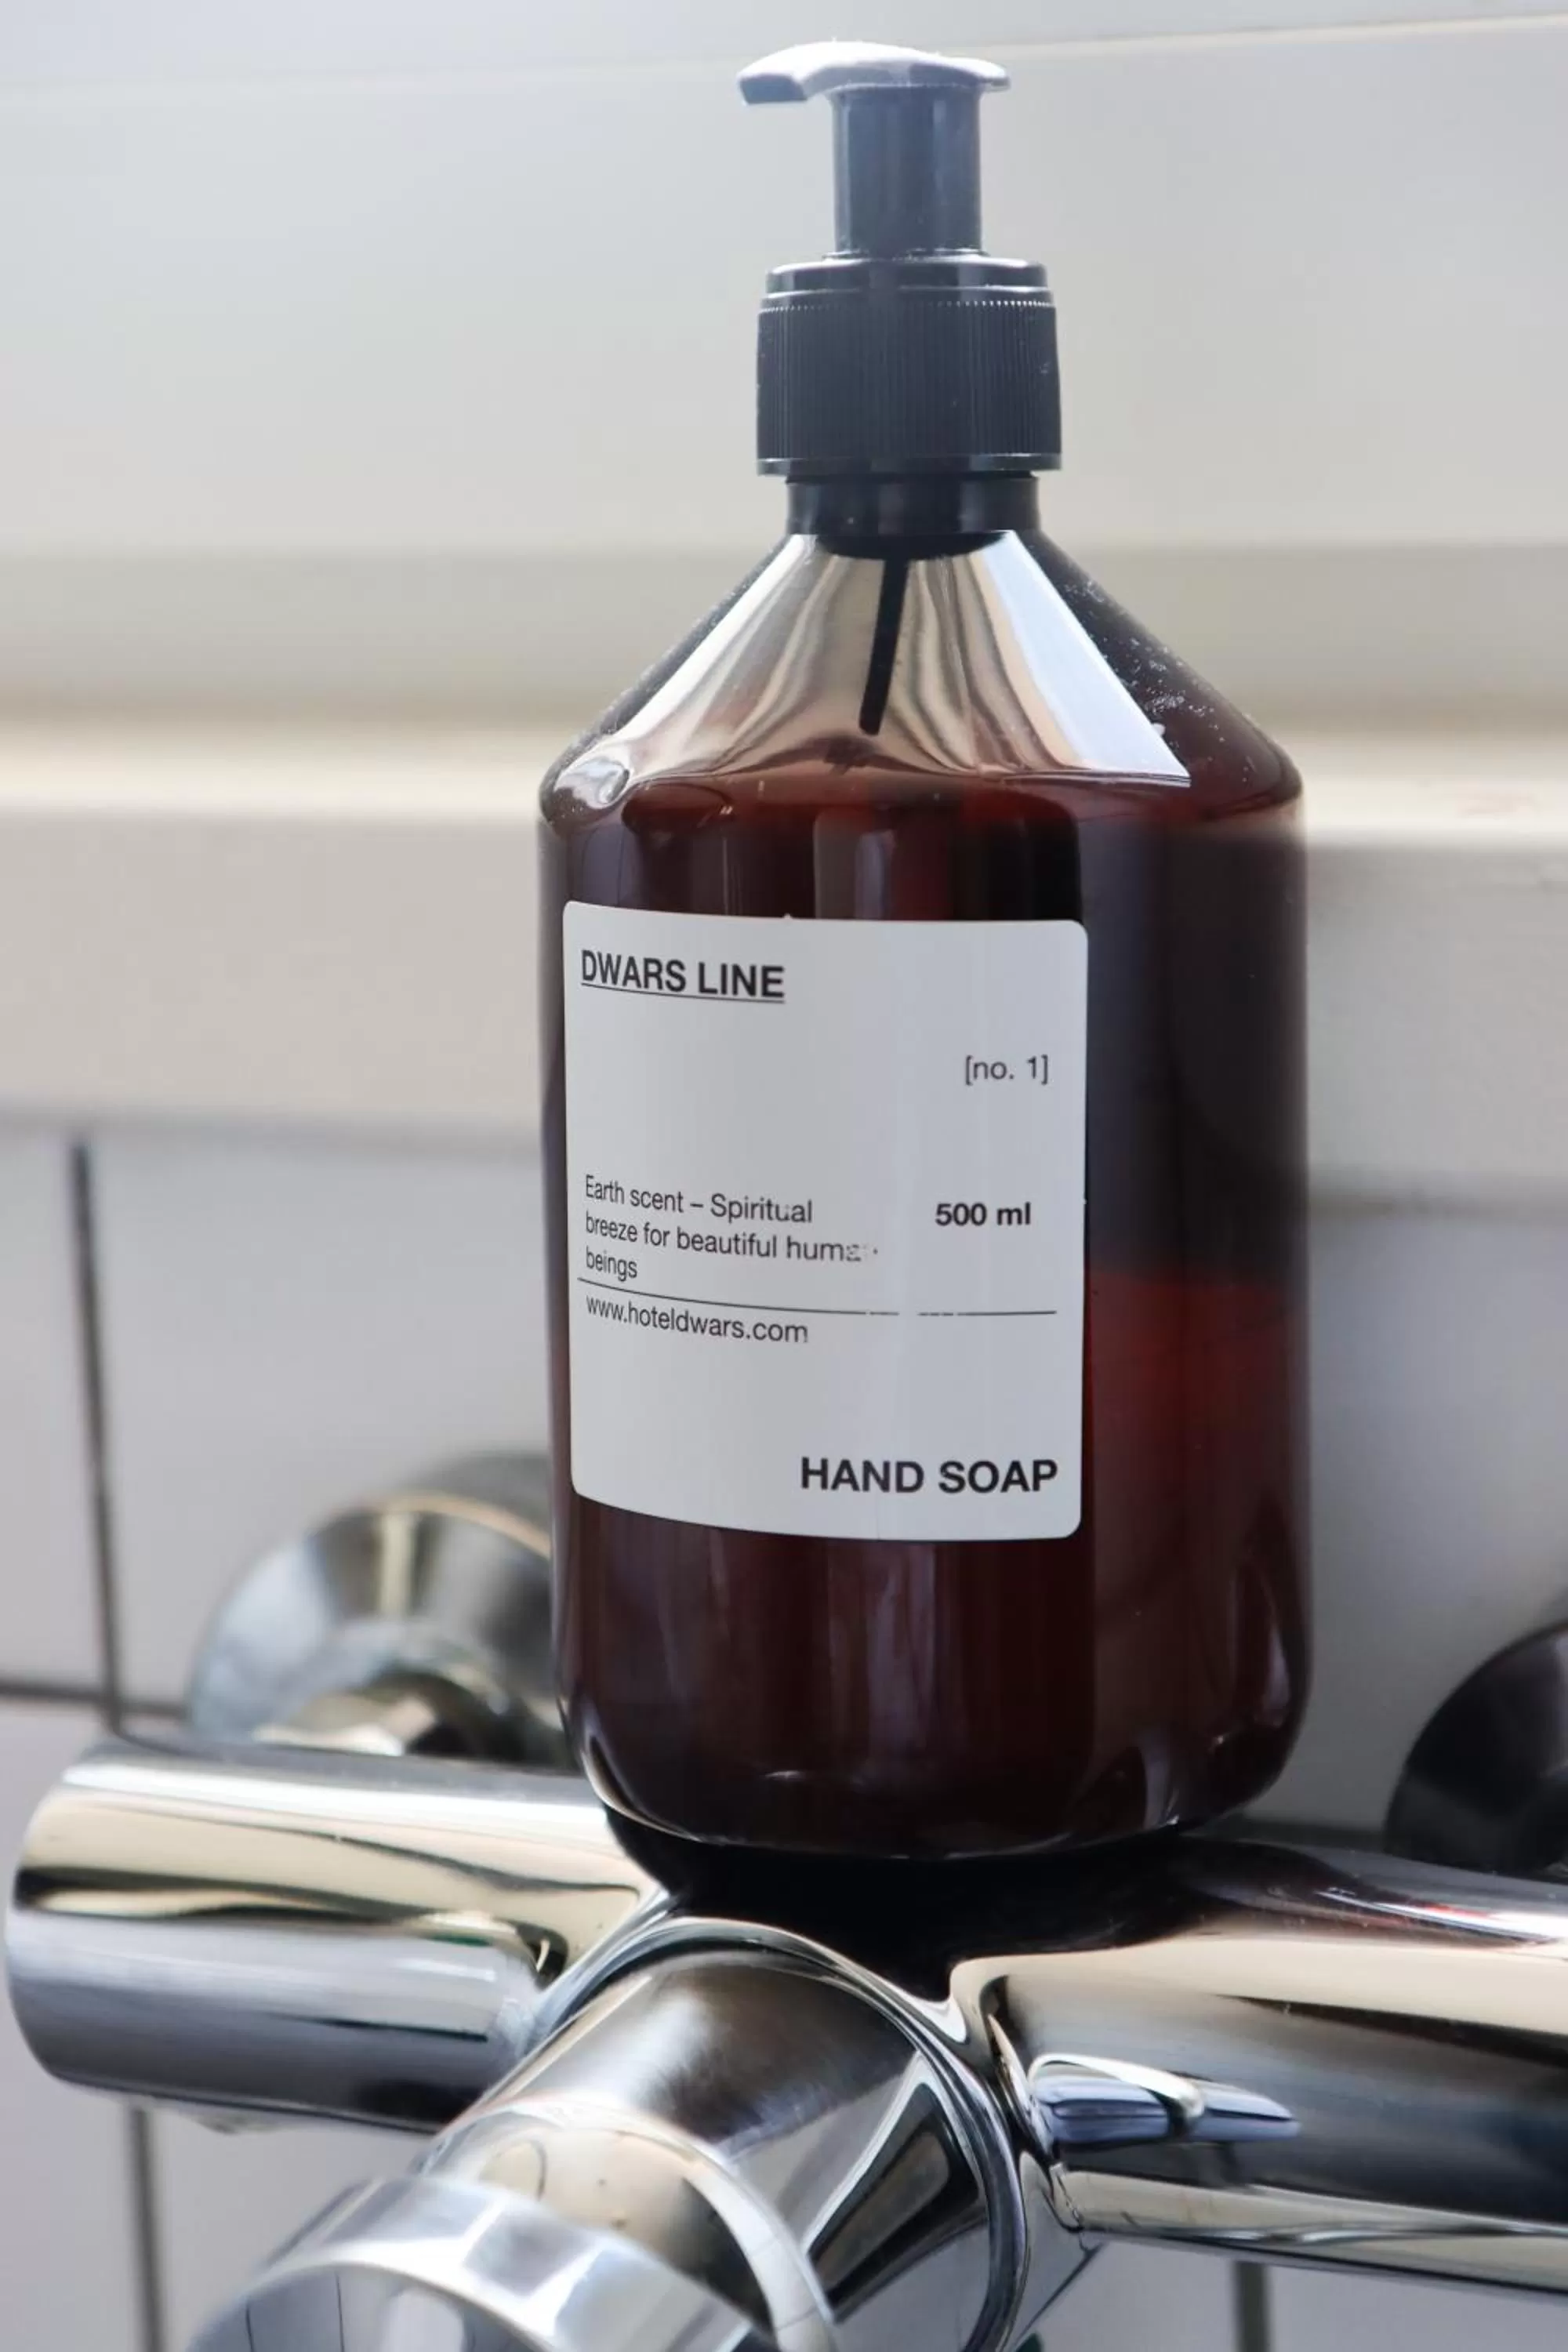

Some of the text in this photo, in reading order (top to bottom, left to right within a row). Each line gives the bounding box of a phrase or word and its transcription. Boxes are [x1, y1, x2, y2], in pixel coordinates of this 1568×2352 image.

[580, 949, 786, 998] DWARS LINE
[964, 1054, 1049, 1087] [no. 1]
[585, 1174, 626, 1205] Earth
[629, 1189, 684, 1214] scent
[710, 1192, 813, 1225] Spiritual
[934, 1200, 1033, 1228] 500 ml
[585, 1210, 879, 1263] breeze for beautiful huma
[585, 1246, 638, 1283] beings
[585, 1296, 809, 1344] www.hoteldwars.com
[800, 1455, 1059, 1495] HAND SOAP
